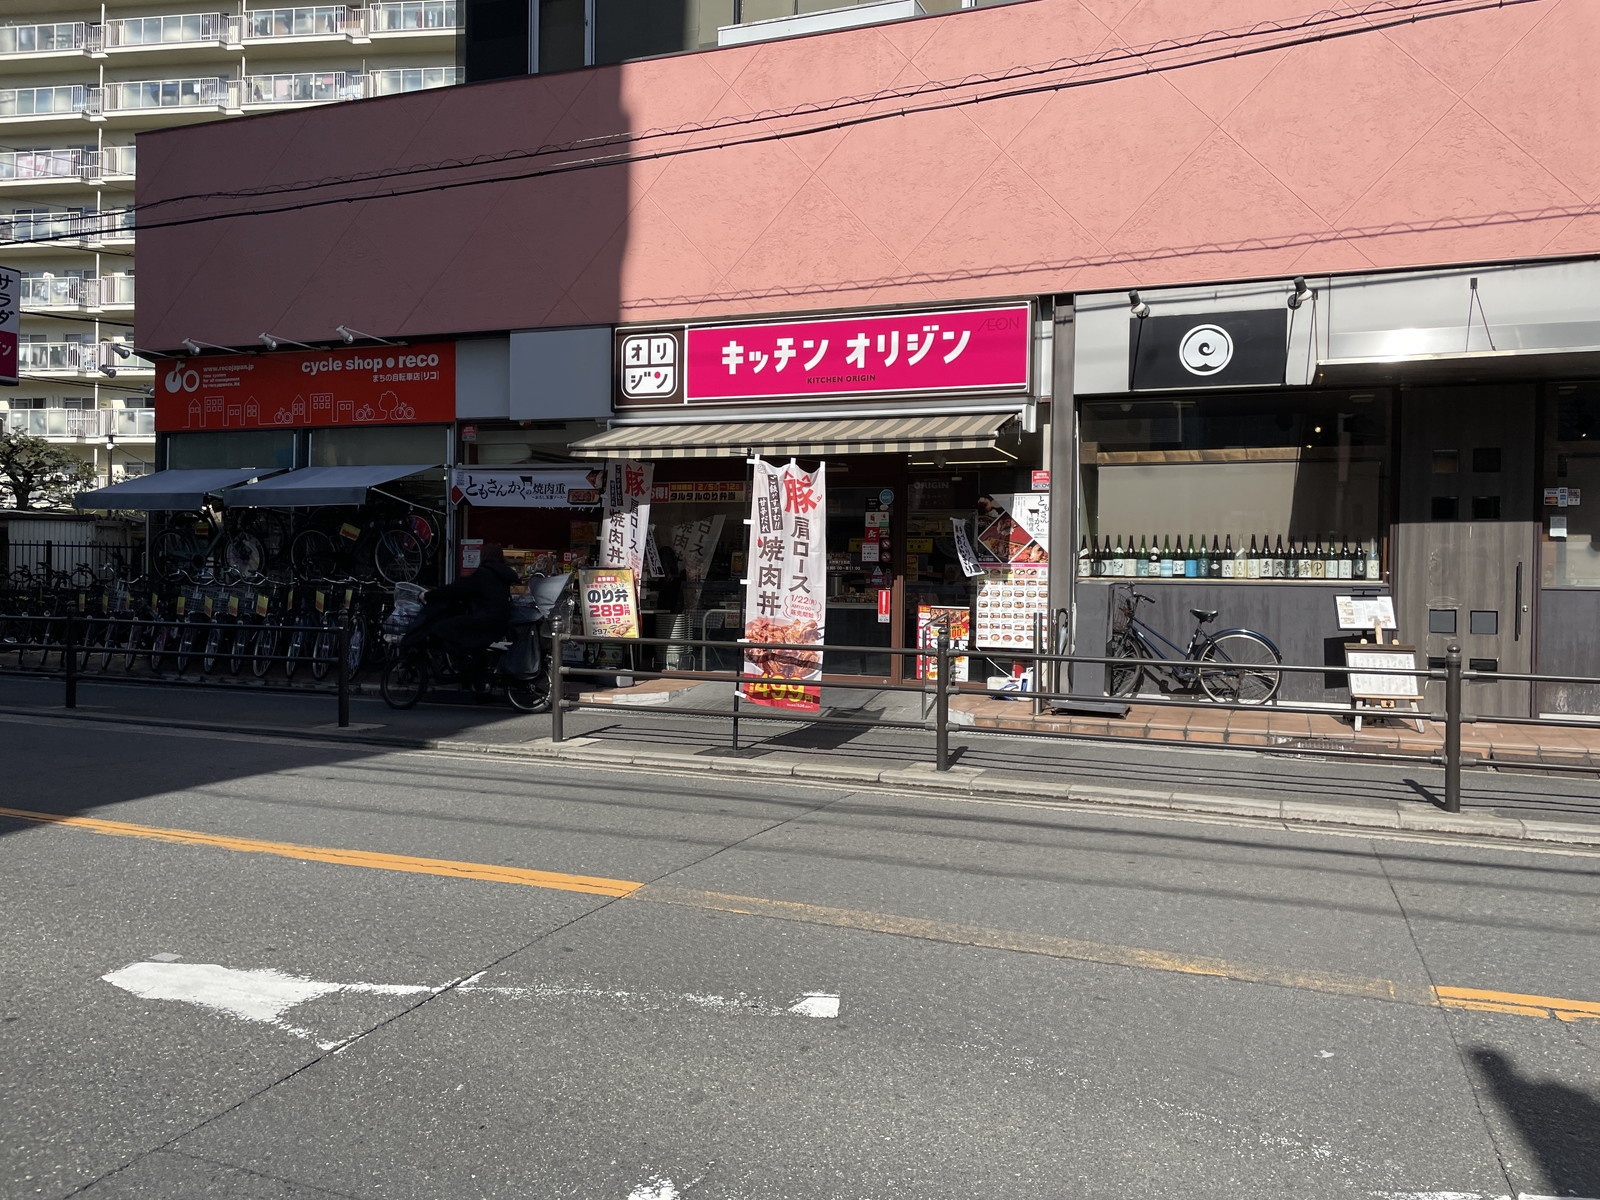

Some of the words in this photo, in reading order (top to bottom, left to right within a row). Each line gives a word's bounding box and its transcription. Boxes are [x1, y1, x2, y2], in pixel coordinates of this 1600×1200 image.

[301, 357, 343, 376] cycle
[345, 356, 383, 373] shop
[398, 353, 439, 369] reco
[721, 338, 830, 376] キッチン
[845, 325, 972, 369] オリジン
[845, 374, 877, 383] ORIGIN
[784, 471, 817, 514] 豚
[607, 509, 625, 564] 焼肉丼
[788, 516, 810, 594] 肩ロース
[587, 589, 629, 604] のり弁
[757, 536, 785, 617] 焼肉丼
